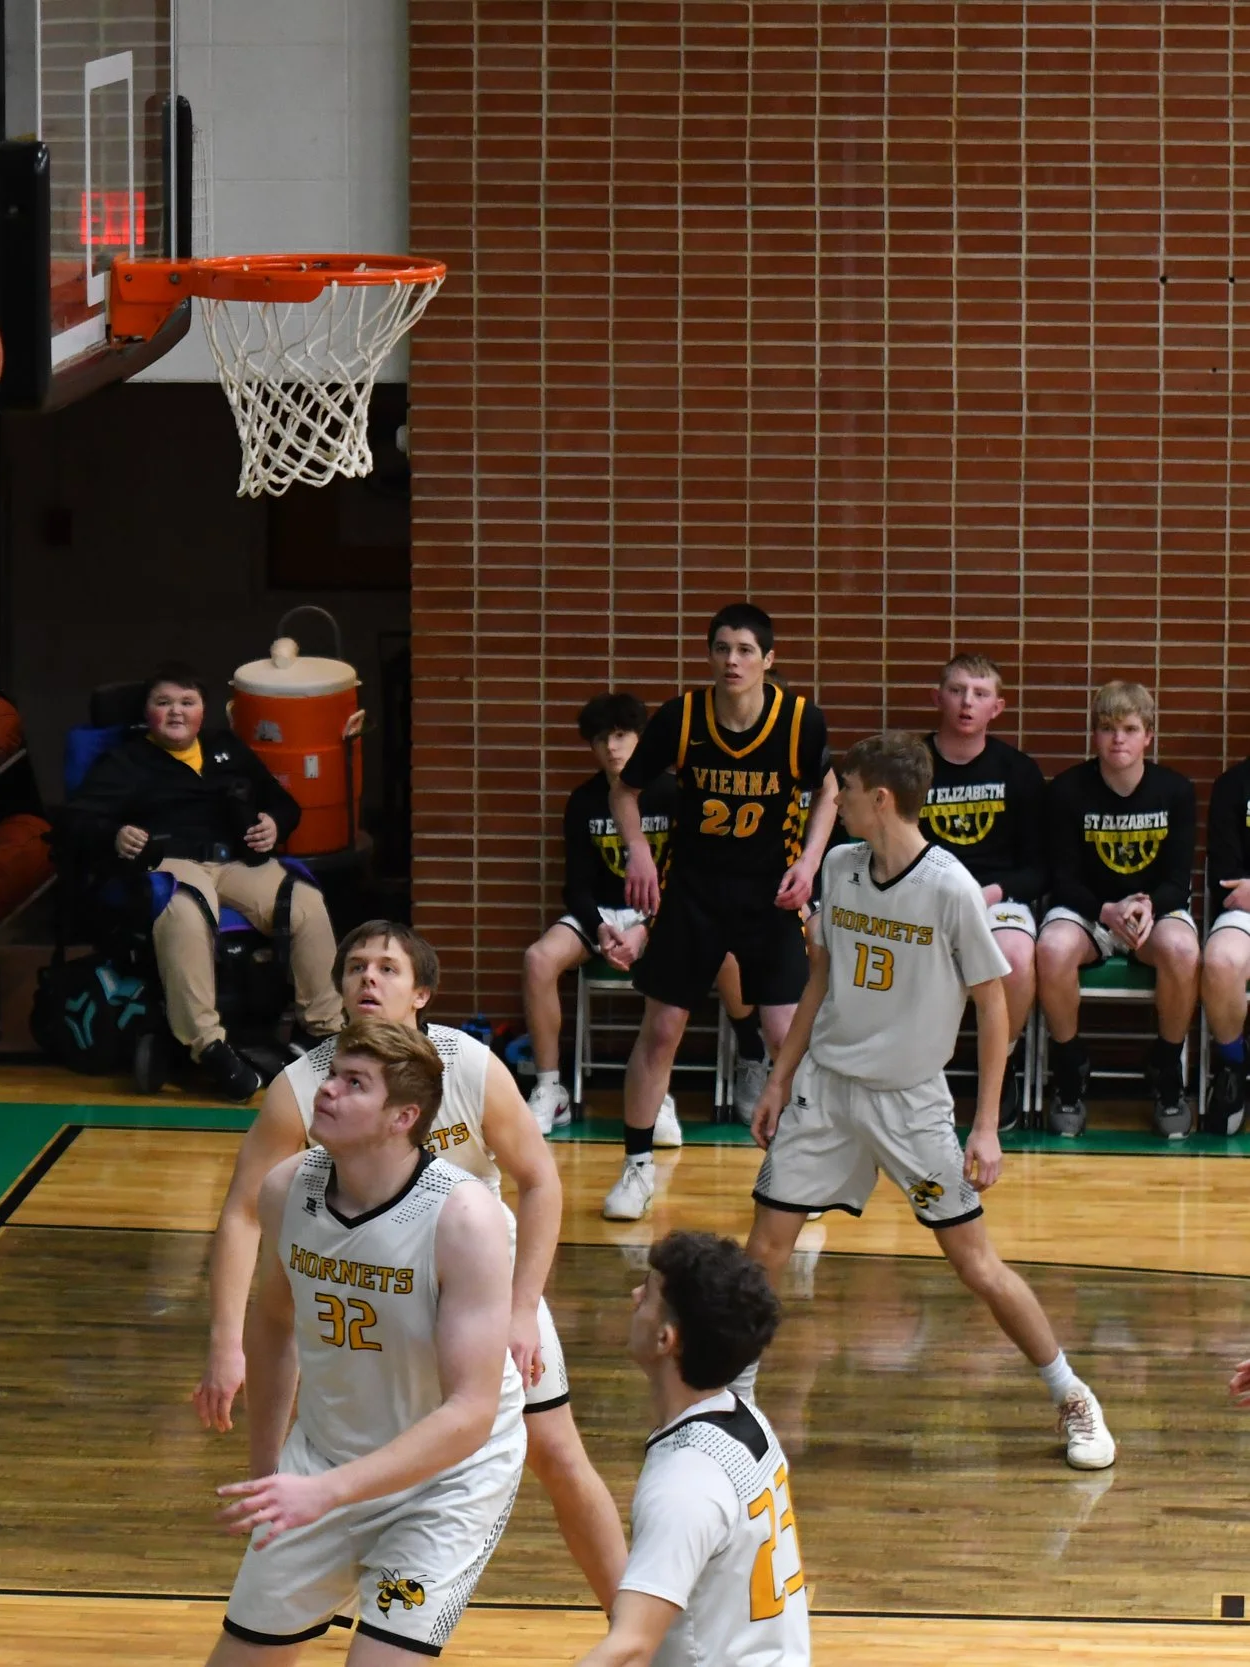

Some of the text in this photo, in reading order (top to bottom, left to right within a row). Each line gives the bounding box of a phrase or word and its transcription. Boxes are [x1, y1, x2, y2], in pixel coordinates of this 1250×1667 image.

[692, 766, 780, 796] VIENNA
[936, 782, 1005, 804] ELIZABETH
[589, 819, 604, 834] ST
[700, 798, 765, 838] 20
[1084, 811, 1168, 830] ST ELIZABETH
[831, 905, 934, 946] HORNETS
[853, 942, 895, 991] 13
[290, 1244, 414, 1294] HORNETS
[315, 1292, 382, 1351] 32
[747, 1462, 804, 1622] 23
